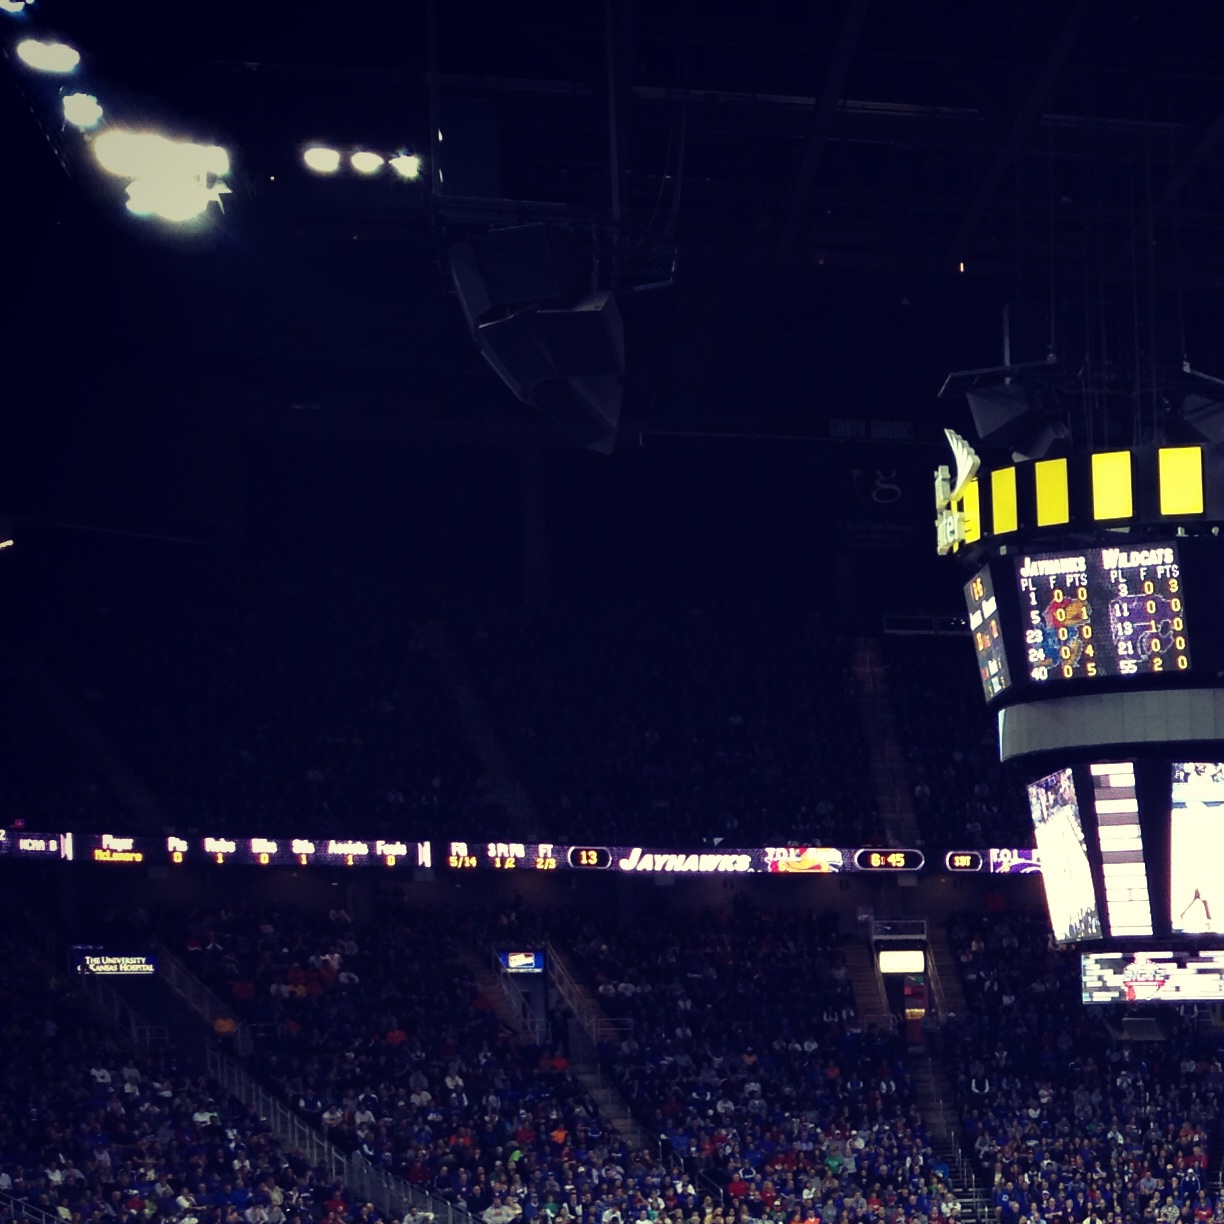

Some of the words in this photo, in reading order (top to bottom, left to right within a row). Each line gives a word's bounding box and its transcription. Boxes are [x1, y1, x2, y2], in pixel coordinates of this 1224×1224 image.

[1111, 570, 1126, 583] PL
[1140, 568, 1147, 580] F
[1157, 565, 1179, 578] PTS
[1021, 579, 1036, 591] PL
[1050, 576, 1056, 588] F
[1066, 574, 1087, 587] PTS
[1118, 584, 1128, 596] 3
[1144, 582, 1154, 594] 0
[1169, 579, 1178, 592] 3
[1030, 593, 1036, 605] 1
[1053, 589, 1063, 602] 0
[1078, 587, 1087, 600] 0
[1147, 601, 1156, 613] 0
[1172, 599, 1181, 611] 0
[1031, 611, 1041, 624] 5
[1056, 608, 1066, 621] 0
[1082, 607, 1088, 619] 1
[1150, 621, 1157, 632] 1
[1174, 618, 1183, 630] 0
[1059, 628, 1068, 640] 0
[1083, 626, 1092, 638] 0
[1061, 646, 1070, 659] 0
[1085, 644, 1094, 656] 4
[1151, 639, 1160, 652] 0
[1176, 637, 1185, 649] 0
[1064, 665, 1073, 678] 0
[1087, 663, 1096, 676] 5
[1153, 659, 1163, 671] 2
[1178, 656, 1187, 669] 0
[580, 851, 597, 865] 13
[619, 848, 751, 871] JAYHAWKS
[870, 853, 905, 866] 6:45
[85, 956, 100, 964] THE
